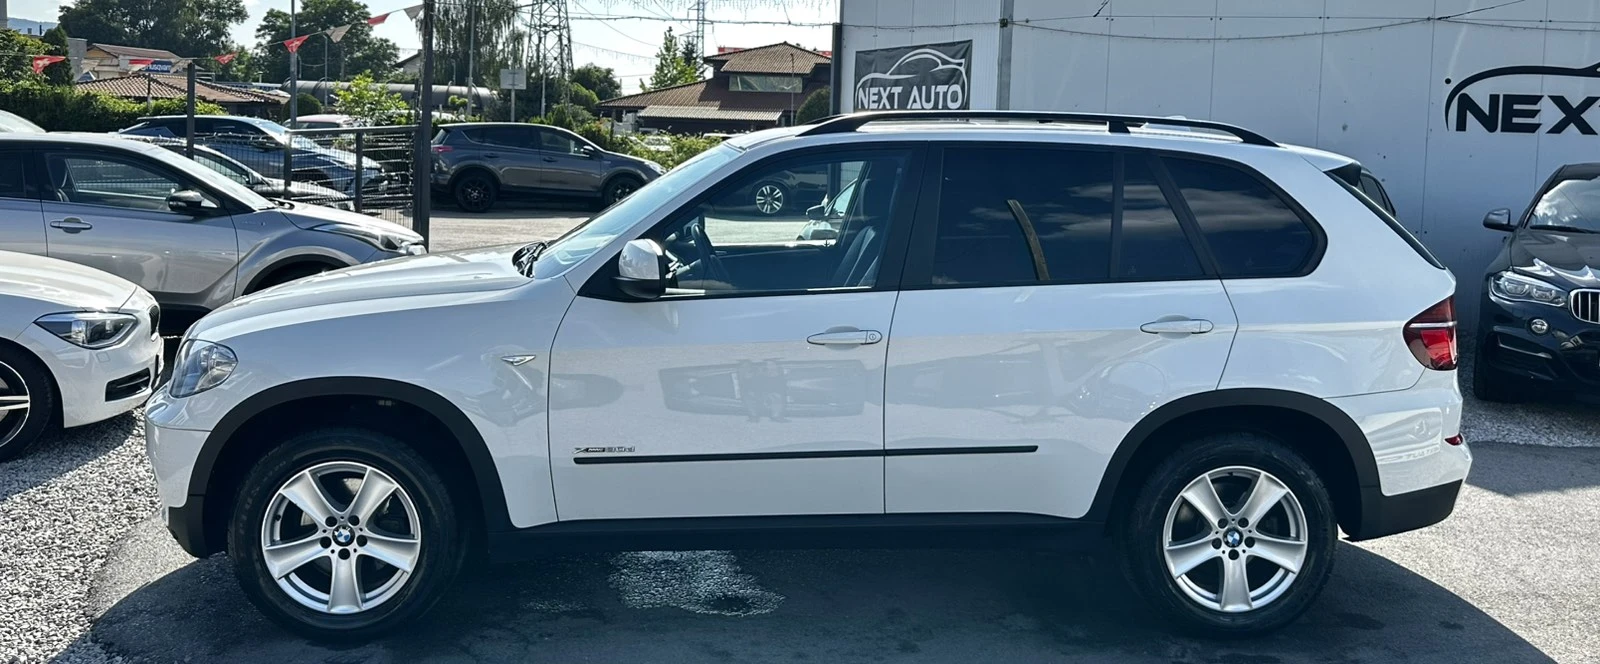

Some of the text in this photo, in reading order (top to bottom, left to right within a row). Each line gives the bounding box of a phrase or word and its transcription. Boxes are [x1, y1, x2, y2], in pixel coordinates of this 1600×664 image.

[858, 84, 963, 109] NEXT AUTO
[1455, 92, 1600, 135] NEX
